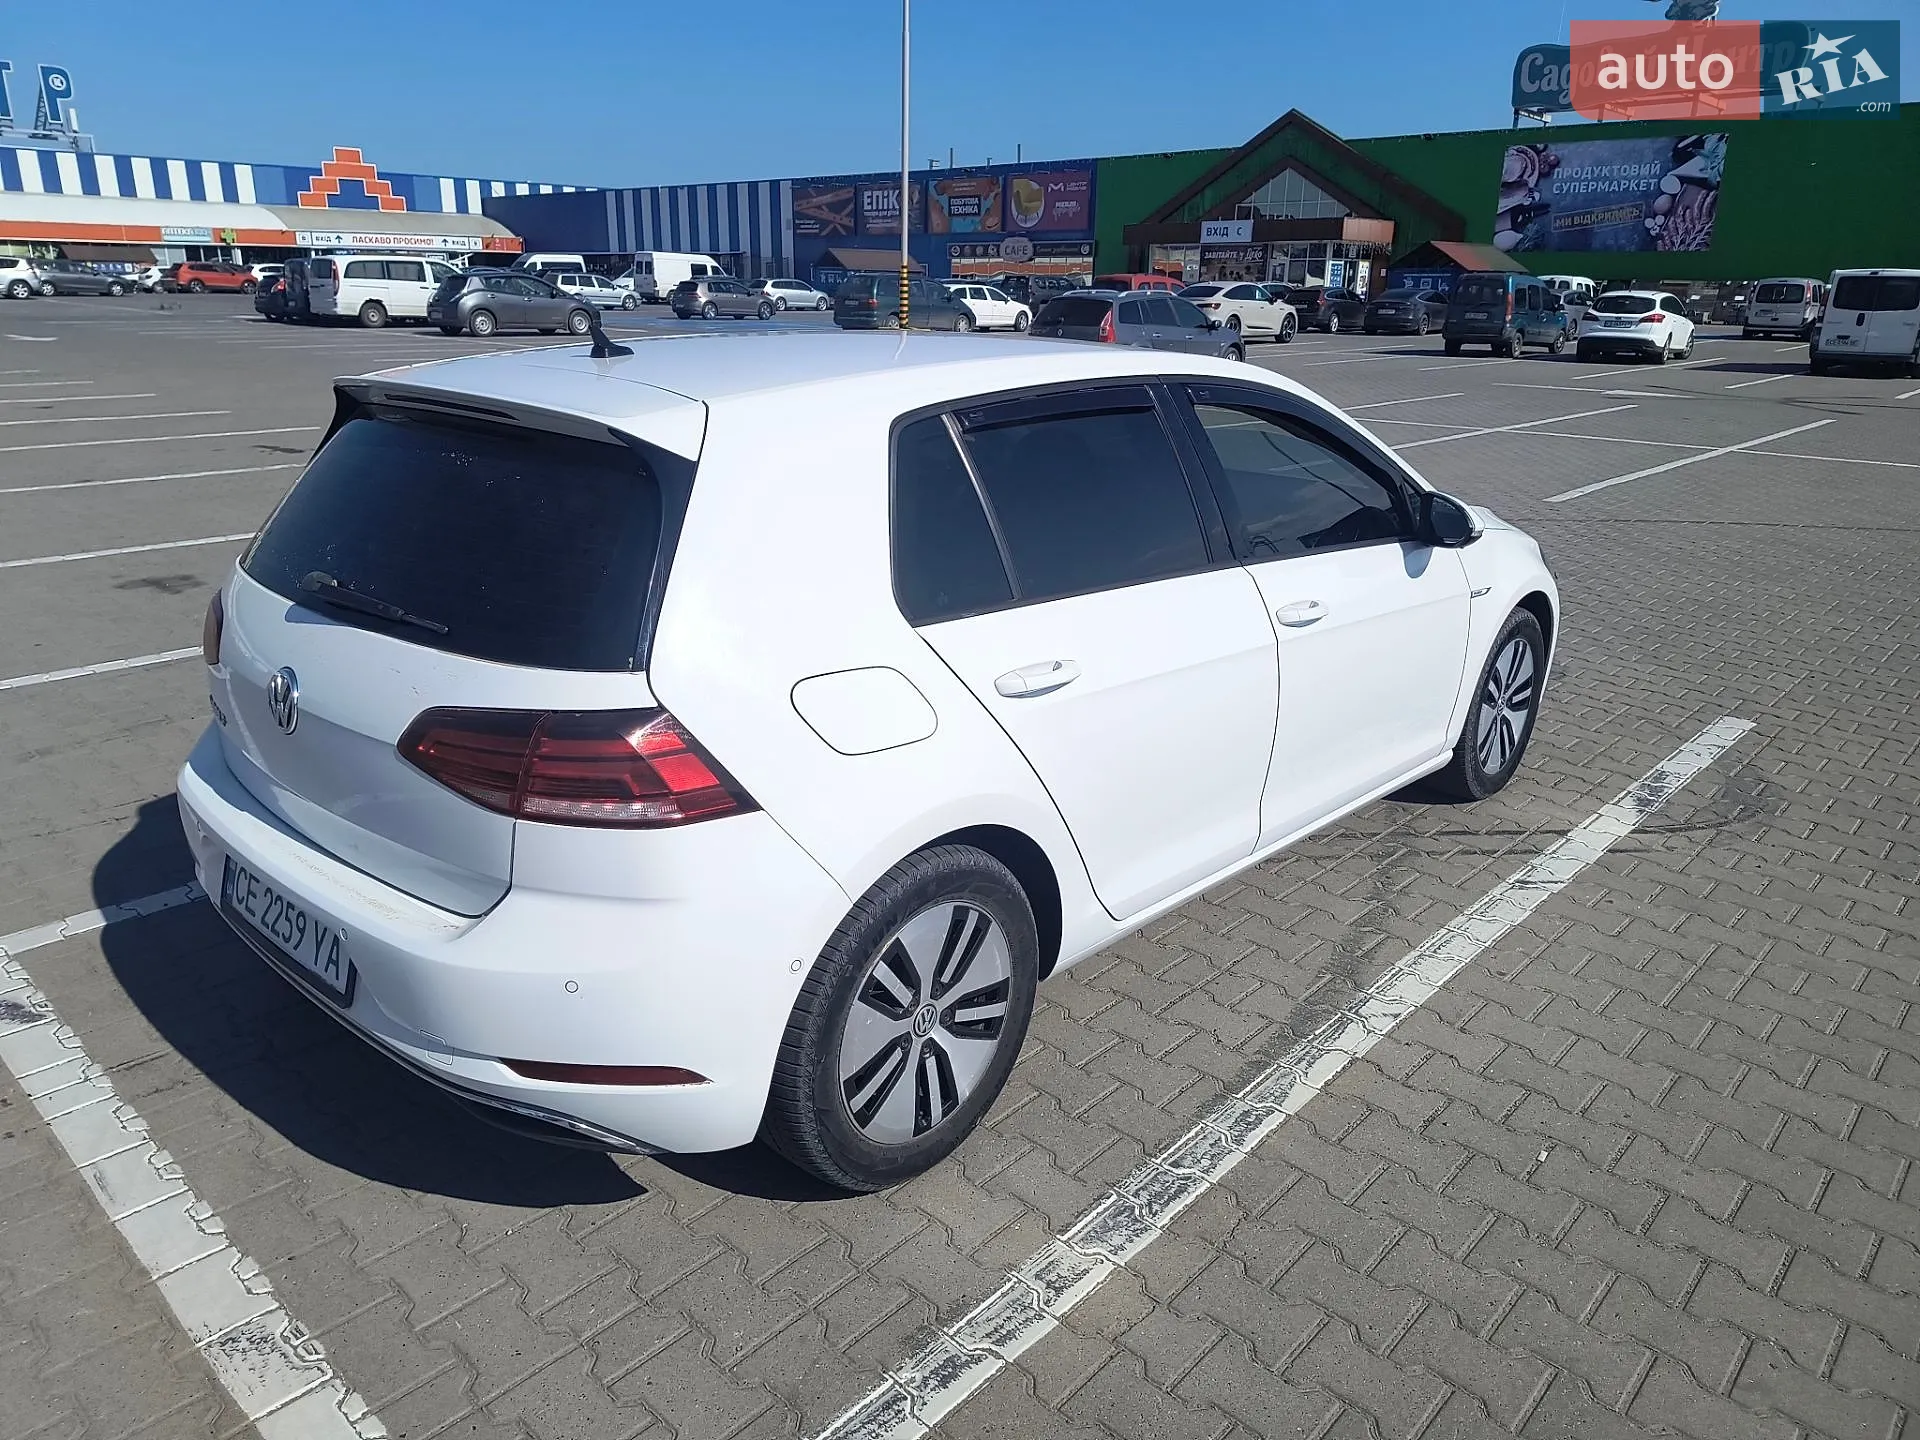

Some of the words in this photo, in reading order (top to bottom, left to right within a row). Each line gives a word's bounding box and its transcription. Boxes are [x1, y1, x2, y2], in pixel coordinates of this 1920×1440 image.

[1520, 44, 1658, 104] Садовй
[1553, 161, 1661, 180] ПРОДУКТОВИЙ
[1552, 179, 1659, 194] СУПЕРМАРКЕТ
[950, 205, 979, 214] ТЕХНІКА
[1206, 226, 1229, 238] ВХІД
[393, 237, 434, 246] ПРОСИМО!
[1004, 245, 1028, 256] CAFE
[236, 866, 260, 918] CE
[260, 887, 307, 951] 2259
[314, 920, 340, 981] YA
